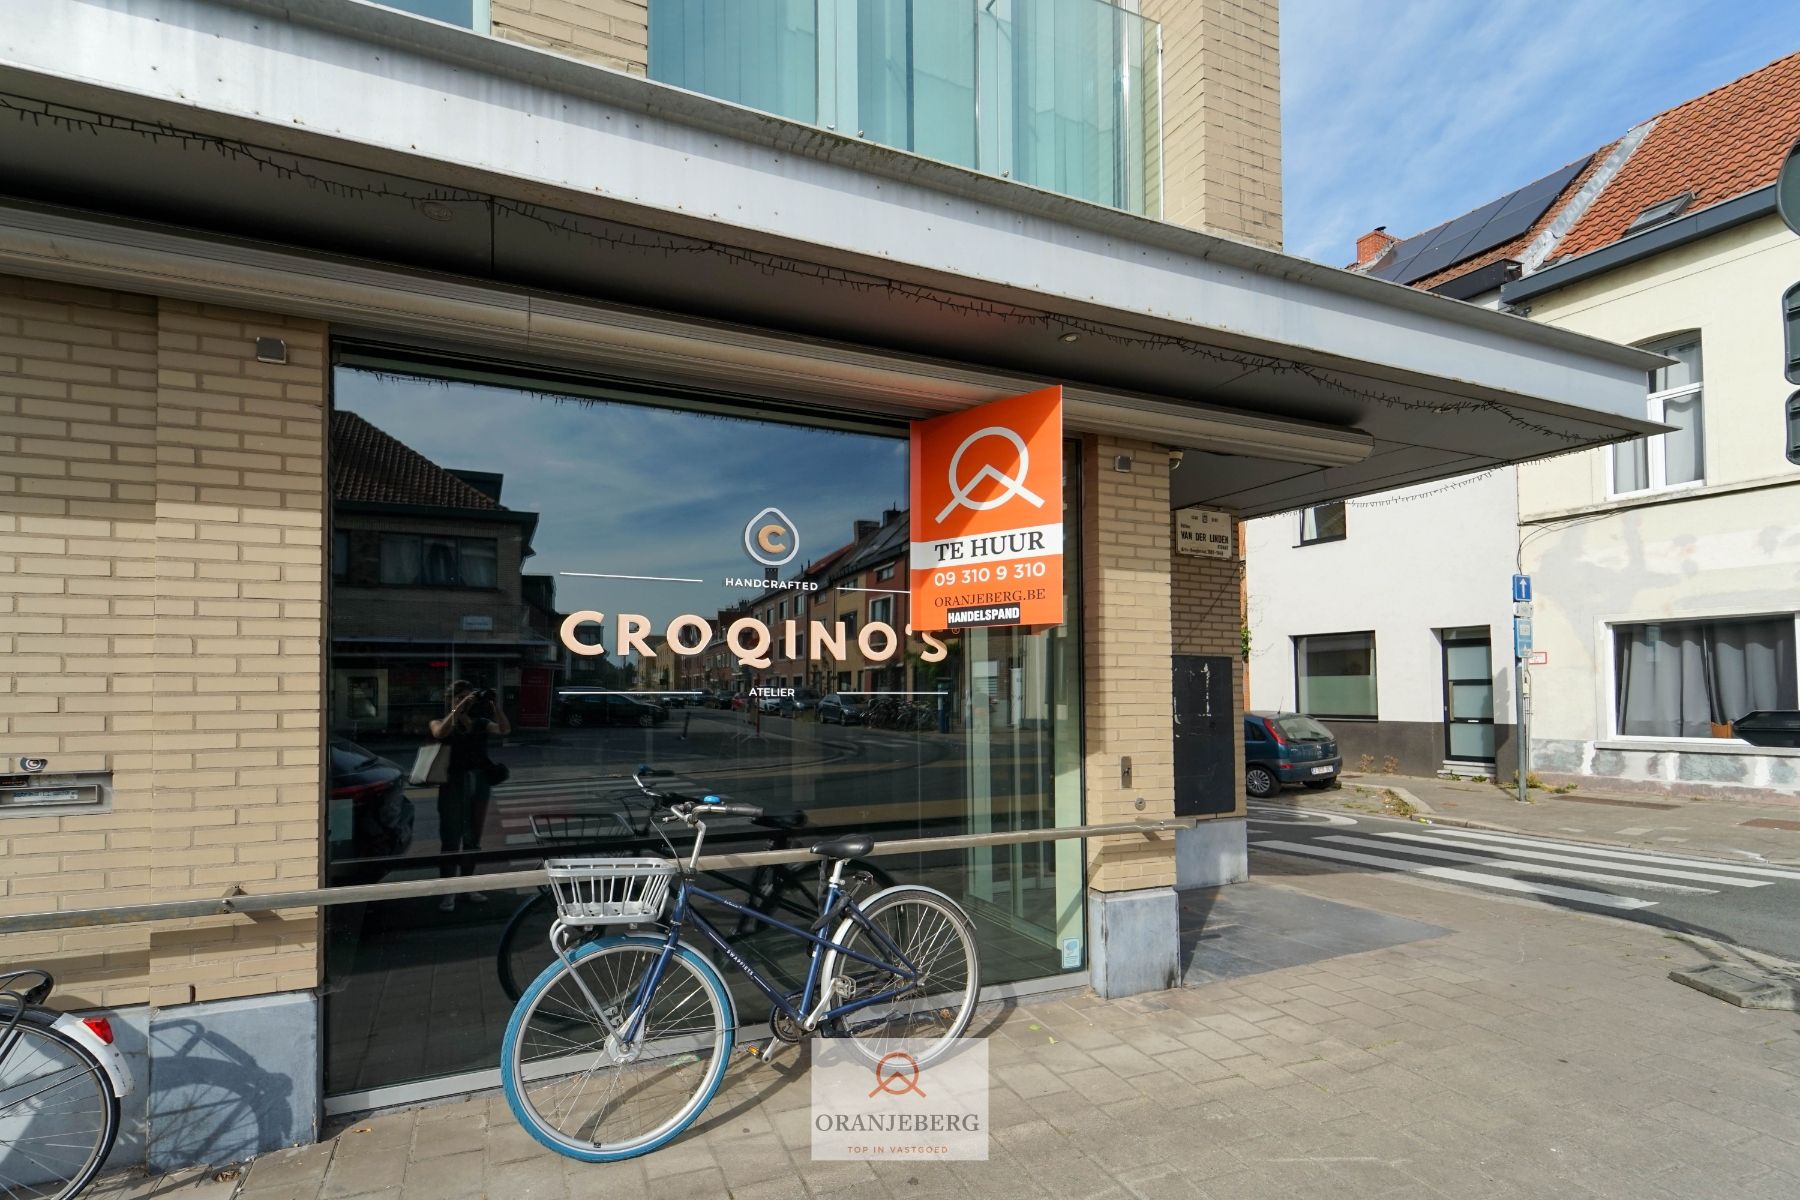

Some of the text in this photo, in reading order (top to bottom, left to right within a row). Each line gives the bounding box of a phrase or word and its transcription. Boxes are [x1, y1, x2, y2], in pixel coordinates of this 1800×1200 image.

[1181, 531, 1192, 540] VAN
[1196, 533, 1206, 541] DER
[934, 530, 1045, 562] TE HUUR
[725, 577, 819, 591] HANDCRAFTED
[934, 562, 1046, 587] 09 310 9 310
[934, 588, 1046, 608] ORANJEBERG.BE
[947, 606, 1020, 624] HANDELSPAND
[560, 610, 948, 669] CROQINO'S
[748, 687, 795, 697] ATELIER
